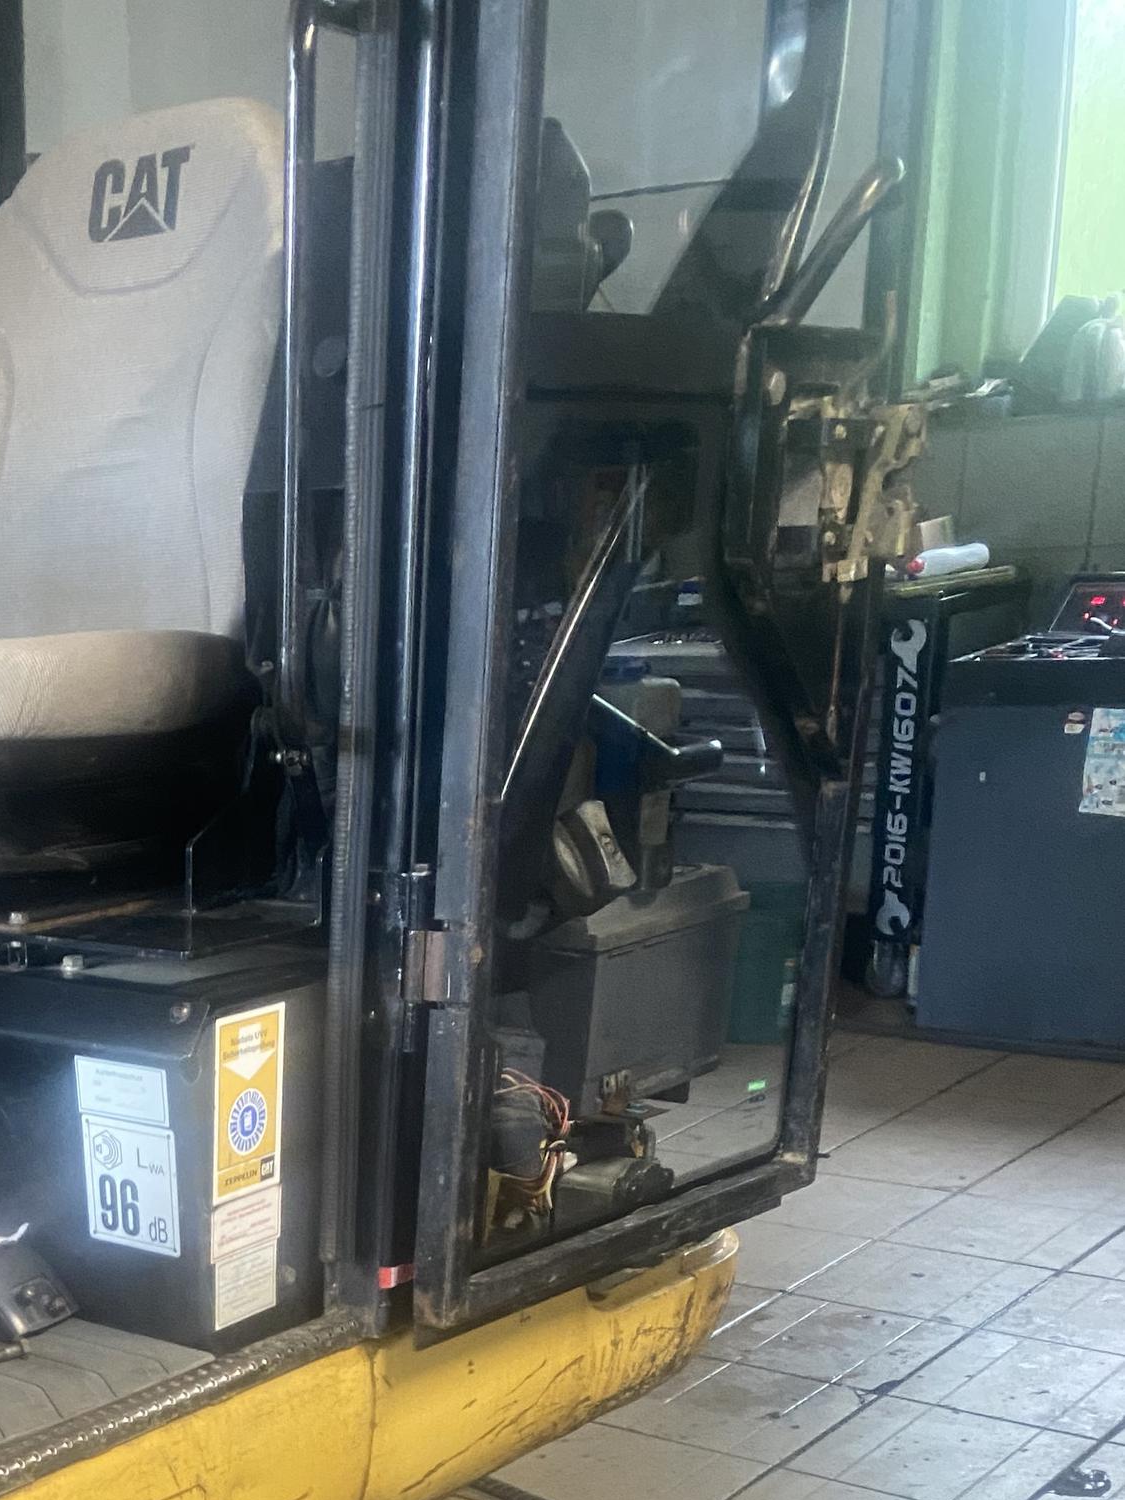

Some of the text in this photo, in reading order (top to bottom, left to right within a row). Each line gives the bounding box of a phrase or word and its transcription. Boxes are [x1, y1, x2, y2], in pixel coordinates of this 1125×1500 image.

[88, 145, 192, 243] CAT
[882, 665, 920, 889] 2016-KW1607
[98, 1173, 141, 1237] 96
[148, 1216, 168, 1244] dB
